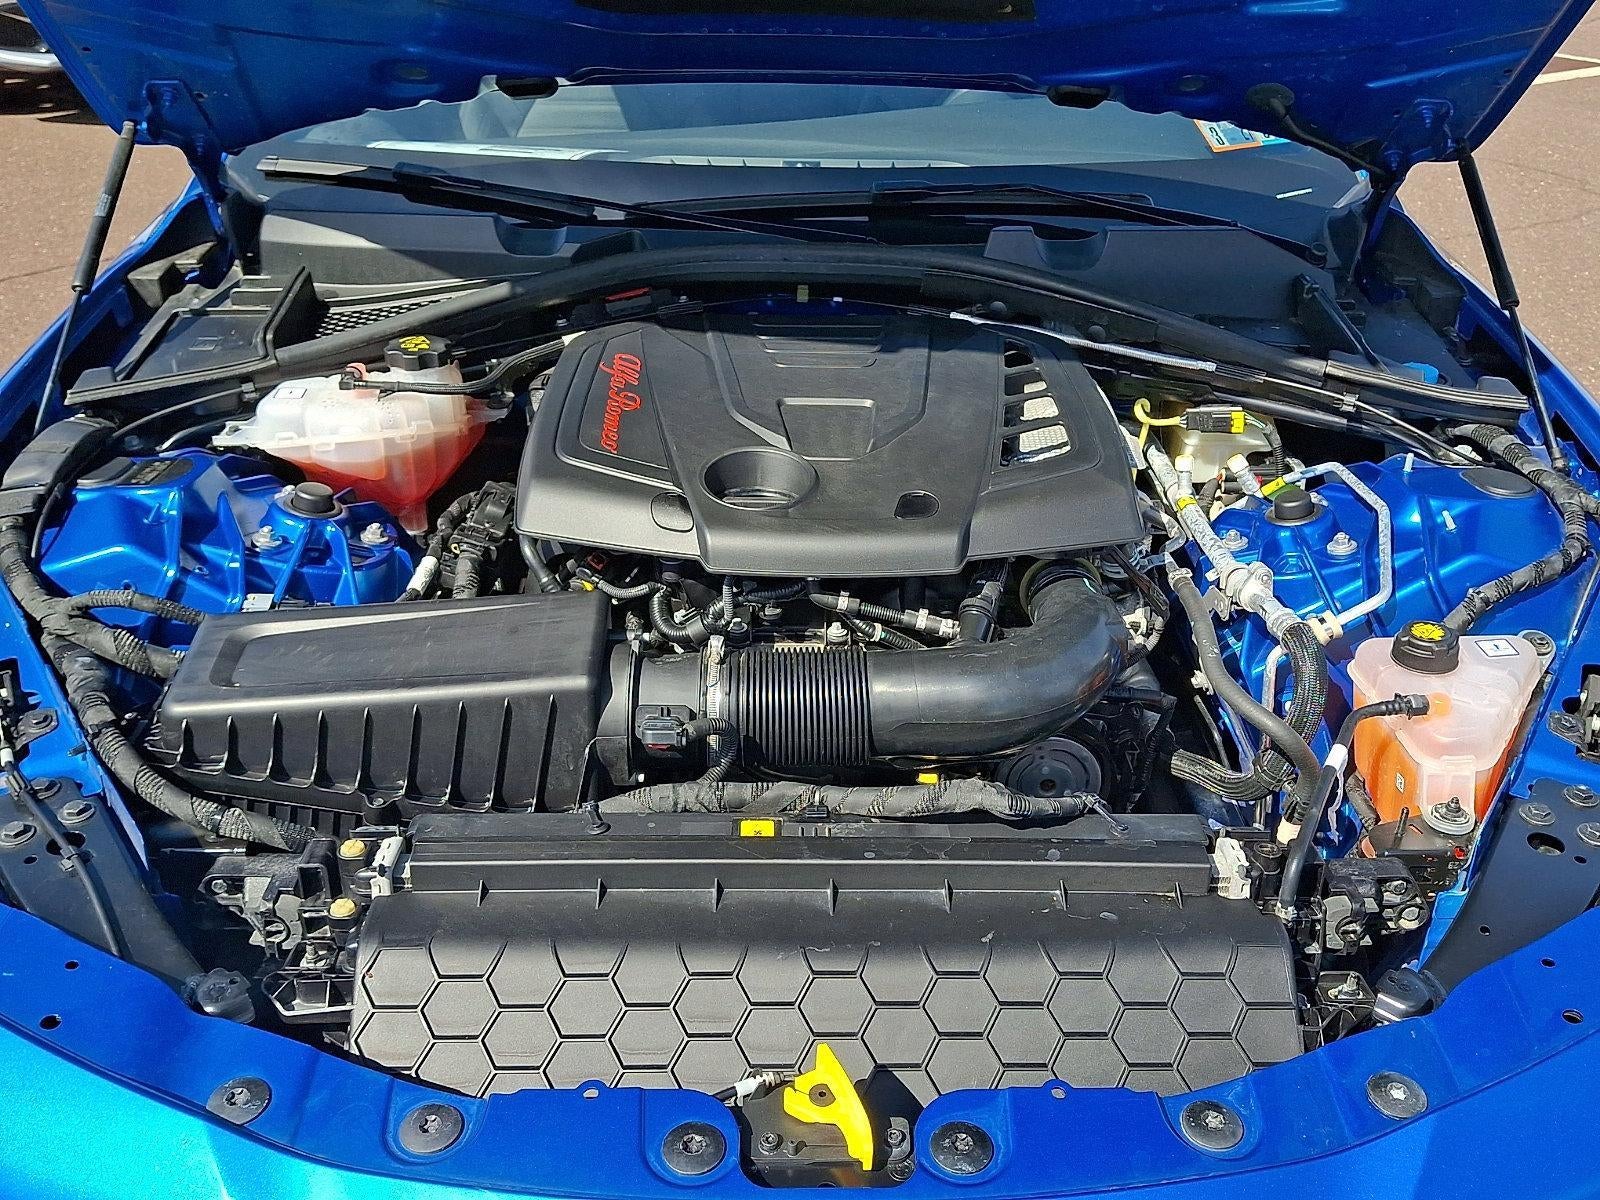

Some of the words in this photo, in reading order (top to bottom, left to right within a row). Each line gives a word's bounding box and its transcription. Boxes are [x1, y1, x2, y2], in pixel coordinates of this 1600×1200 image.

[1208, 126, 1225, 145] 3
[599, 353, 641, 390] Alfa
[600, 389, 641, 454] Romeo
